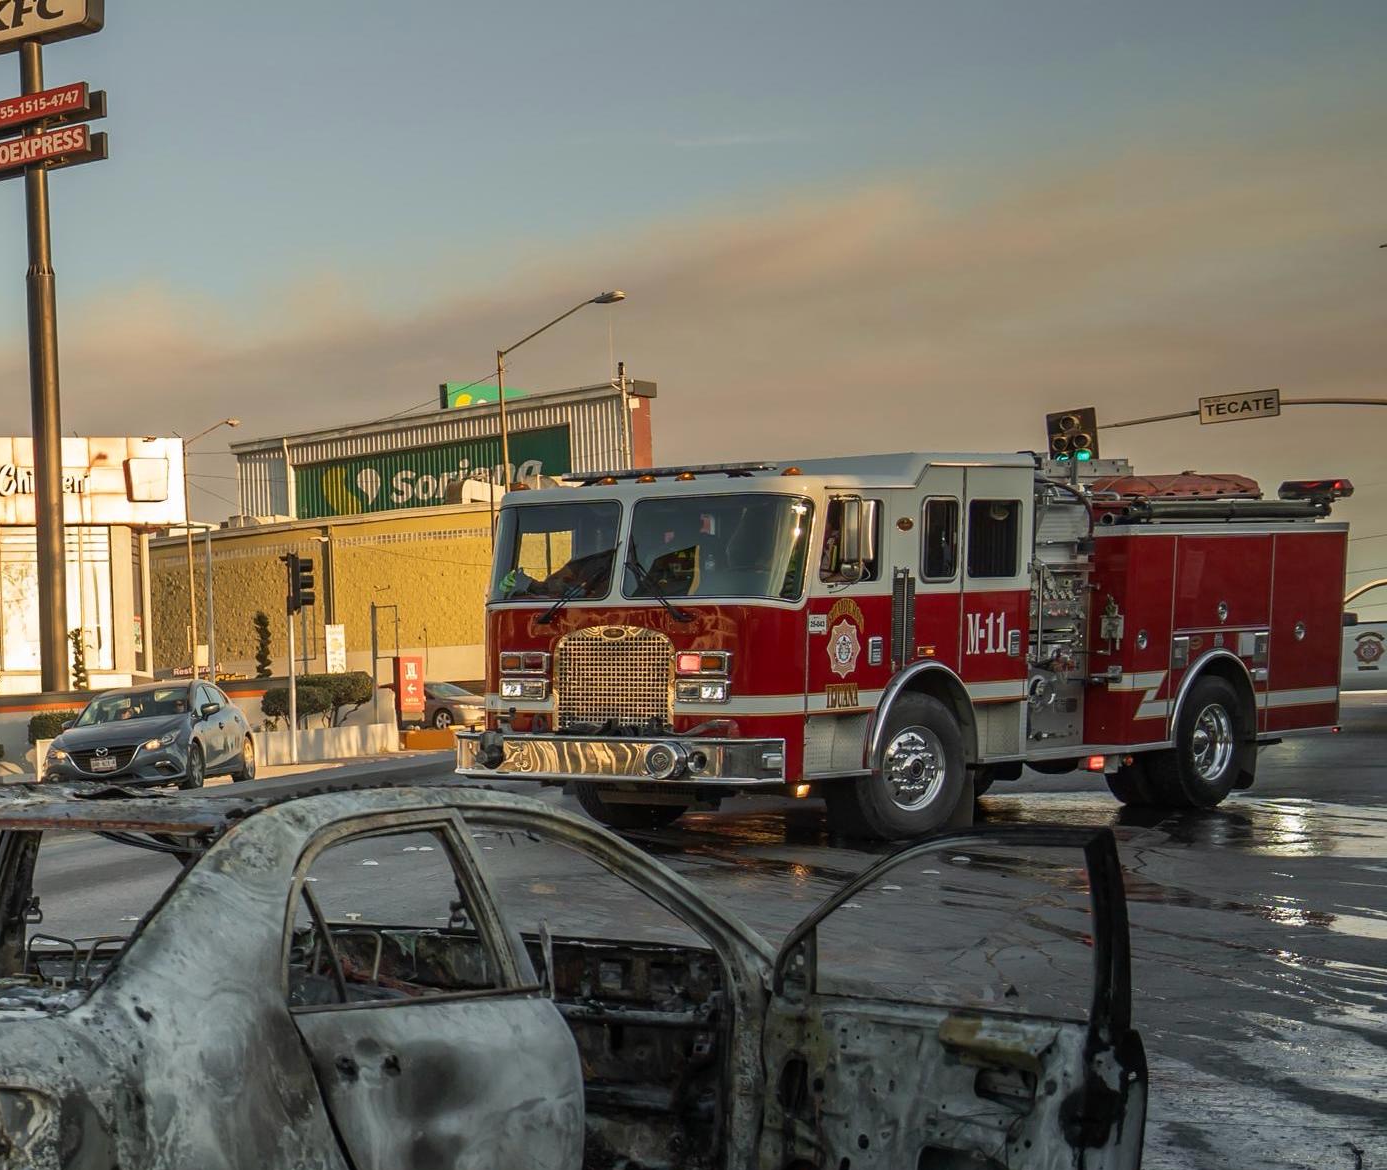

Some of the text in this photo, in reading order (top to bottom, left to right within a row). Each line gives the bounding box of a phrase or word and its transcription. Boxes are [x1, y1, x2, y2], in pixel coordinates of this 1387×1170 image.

[0, 90, 79, 119] 55-1515-4747
[1205, 397, 1275, 416] TECATE
[966, 611, 1007, 655] M-11
